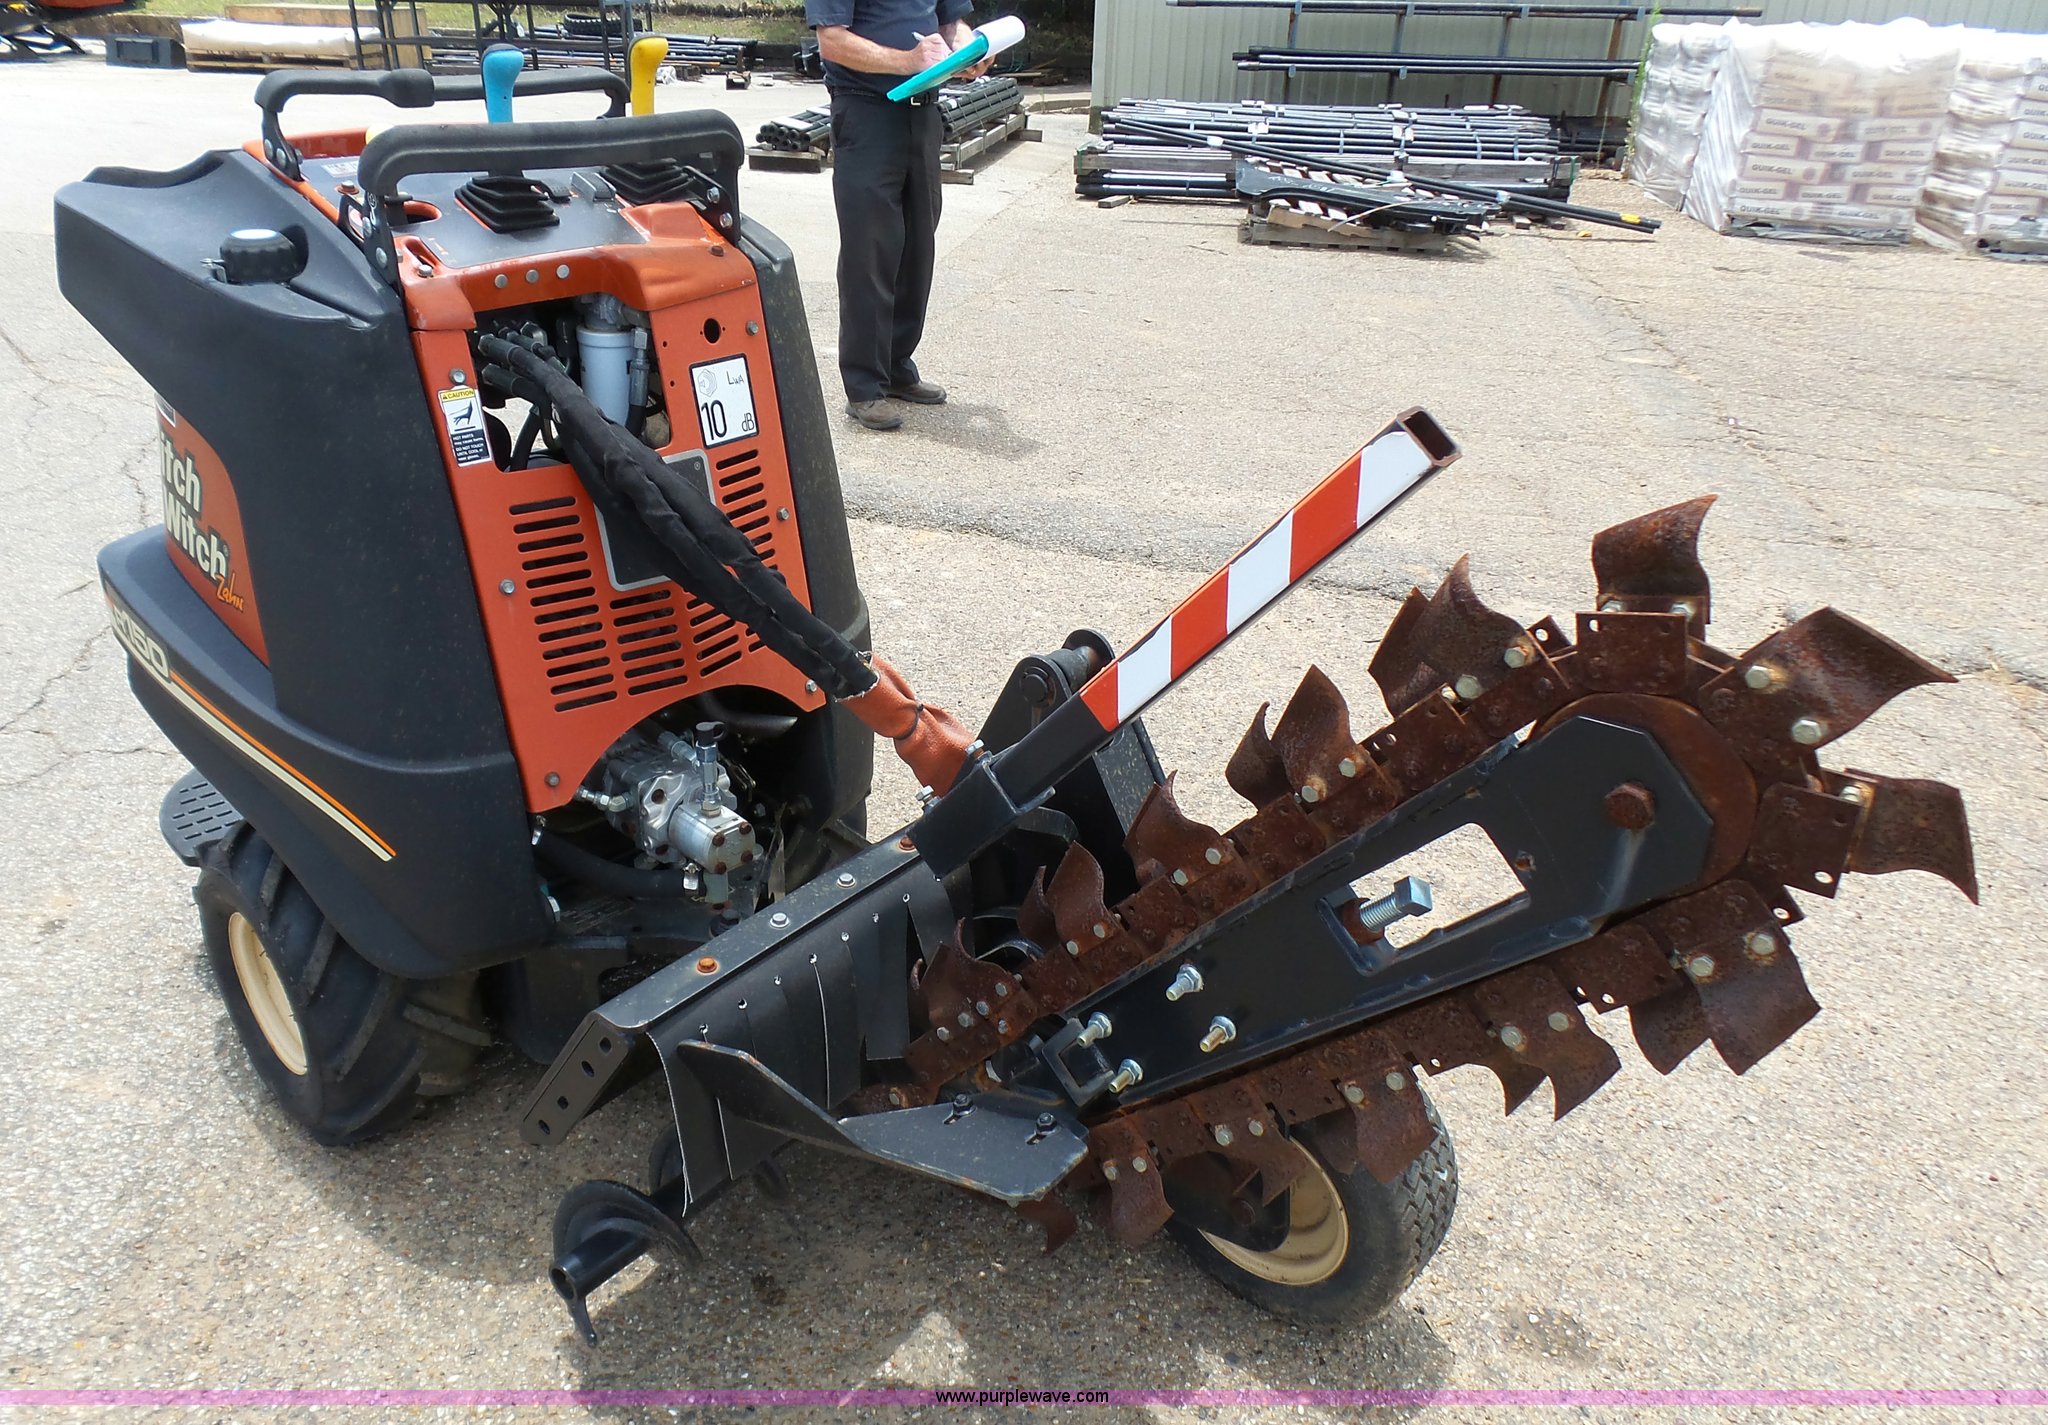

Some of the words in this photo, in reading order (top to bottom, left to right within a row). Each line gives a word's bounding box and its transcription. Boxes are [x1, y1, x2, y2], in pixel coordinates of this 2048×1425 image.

[1766, 118, 1806, 131] QUIK-GEL
[1752, 163, 1793, 175] QUIK-GEL
[1740, 205, 1781, 215] QUIK-GEL
[448, 390, 474, 400] CAUTION
[701, 399, 728, 441] 10
[741, 412, 755, 432] dB
[166, 492, 228, 581] Witch
